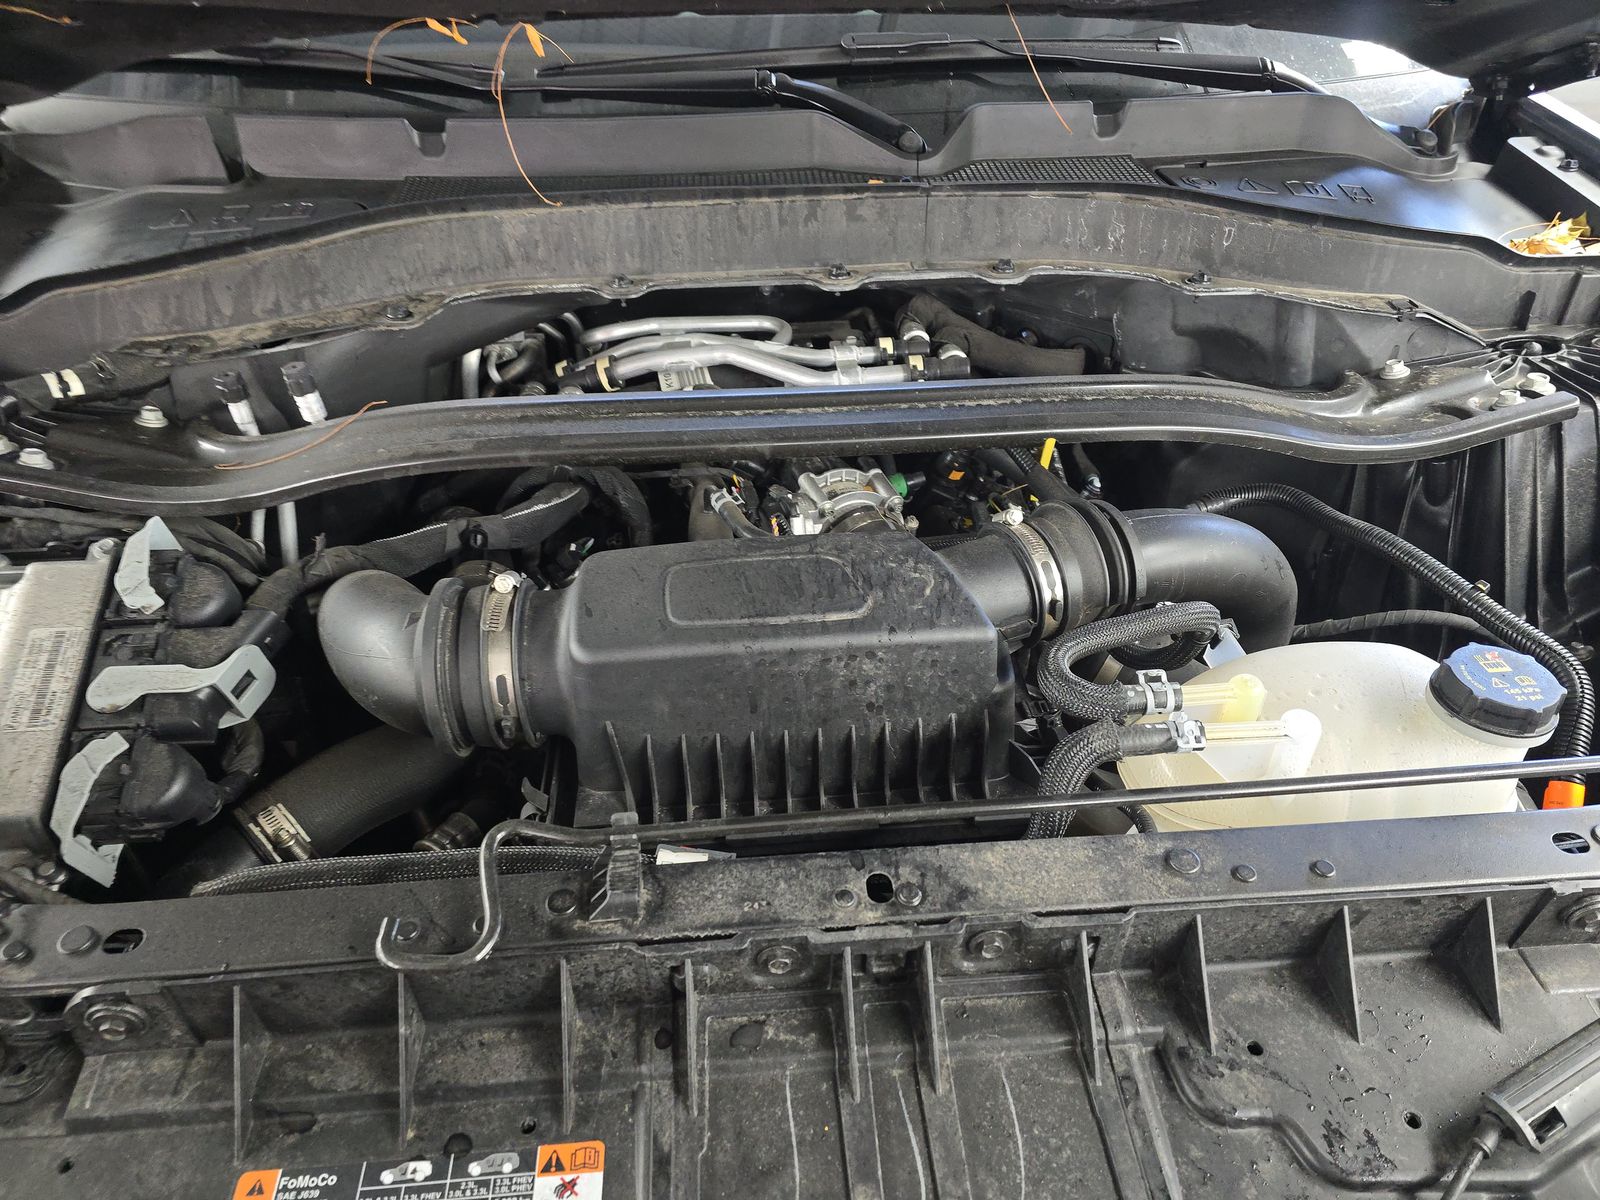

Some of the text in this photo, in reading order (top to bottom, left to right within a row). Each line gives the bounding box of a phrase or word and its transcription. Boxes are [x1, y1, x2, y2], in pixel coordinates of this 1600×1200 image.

[279, 1173, 338, 1190] FoMoCo
[512, 1175, 534, 1184] FHEV
[511, 1183, 533, 1192] PHEV
[297, 1189, 320, 1200] J639
